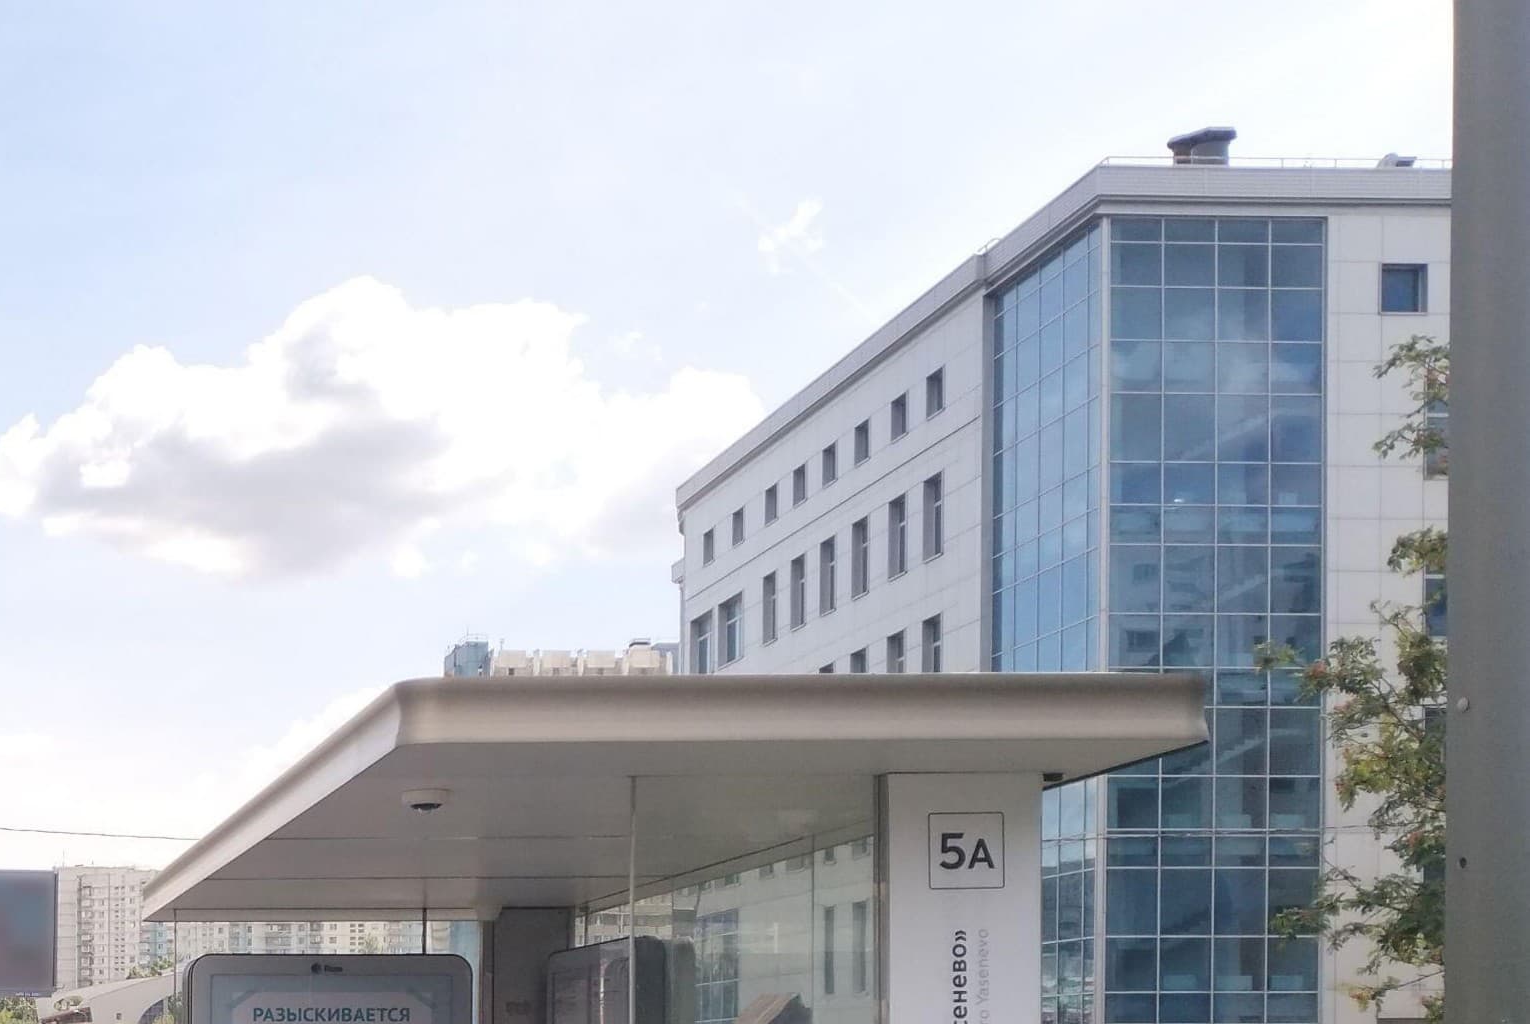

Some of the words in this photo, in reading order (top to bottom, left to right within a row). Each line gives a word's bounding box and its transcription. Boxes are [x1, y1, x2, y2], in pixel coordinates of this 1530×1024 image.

[939, 832, 995, 870] 5А
[977, 928, 991, 1006] Yasenevo
[253, 1007, 410, 1022] РАЗЫСКИВАЕТСЯ
